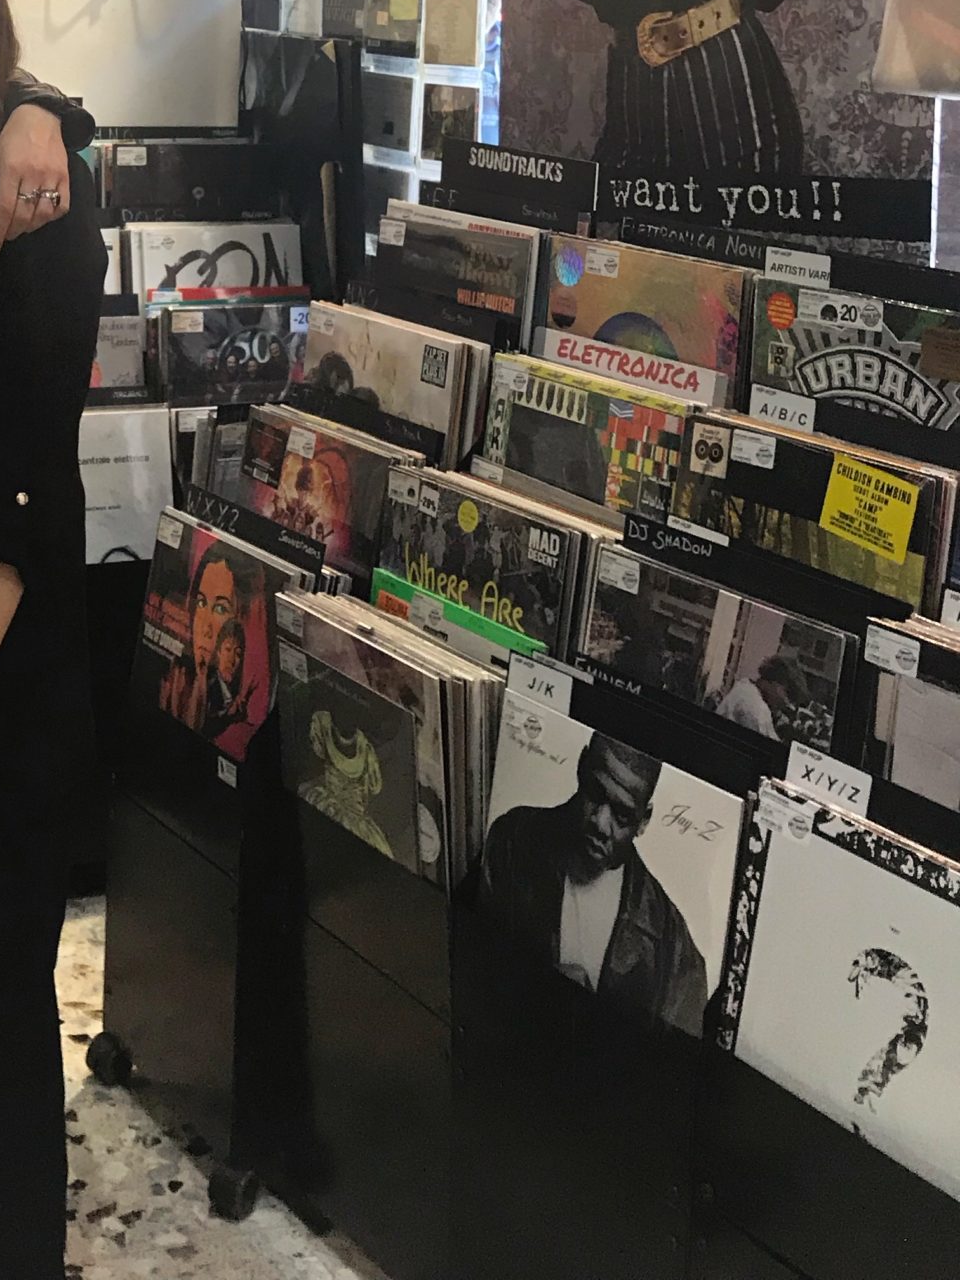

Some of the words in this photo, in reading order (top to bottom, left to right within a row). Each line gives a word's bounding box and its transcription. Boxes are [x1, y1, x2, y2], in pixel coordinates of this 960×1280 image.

[468, 146, 564, 183] SOUNDTRACKS
[610, 176, 703, 214] want
[717, 180, 843, 228] you!!
[770, 261, 807, 278] ARTISTI
[557, 337, 700, 393] ELETTRONICA
[801, 352, 939, 421] URBAN
[836, 462, 872, 487] CHILDISH
[874, 478, 913, 506] GAMBINO
[528, 525, 561, 557] MAD
[628, 519, 649, 541] DJ
[652, 529, 713, 558] SHADOW
[527, 547, 558, 569] DECENT
[661, 804, 724, 842] Jay-Z
